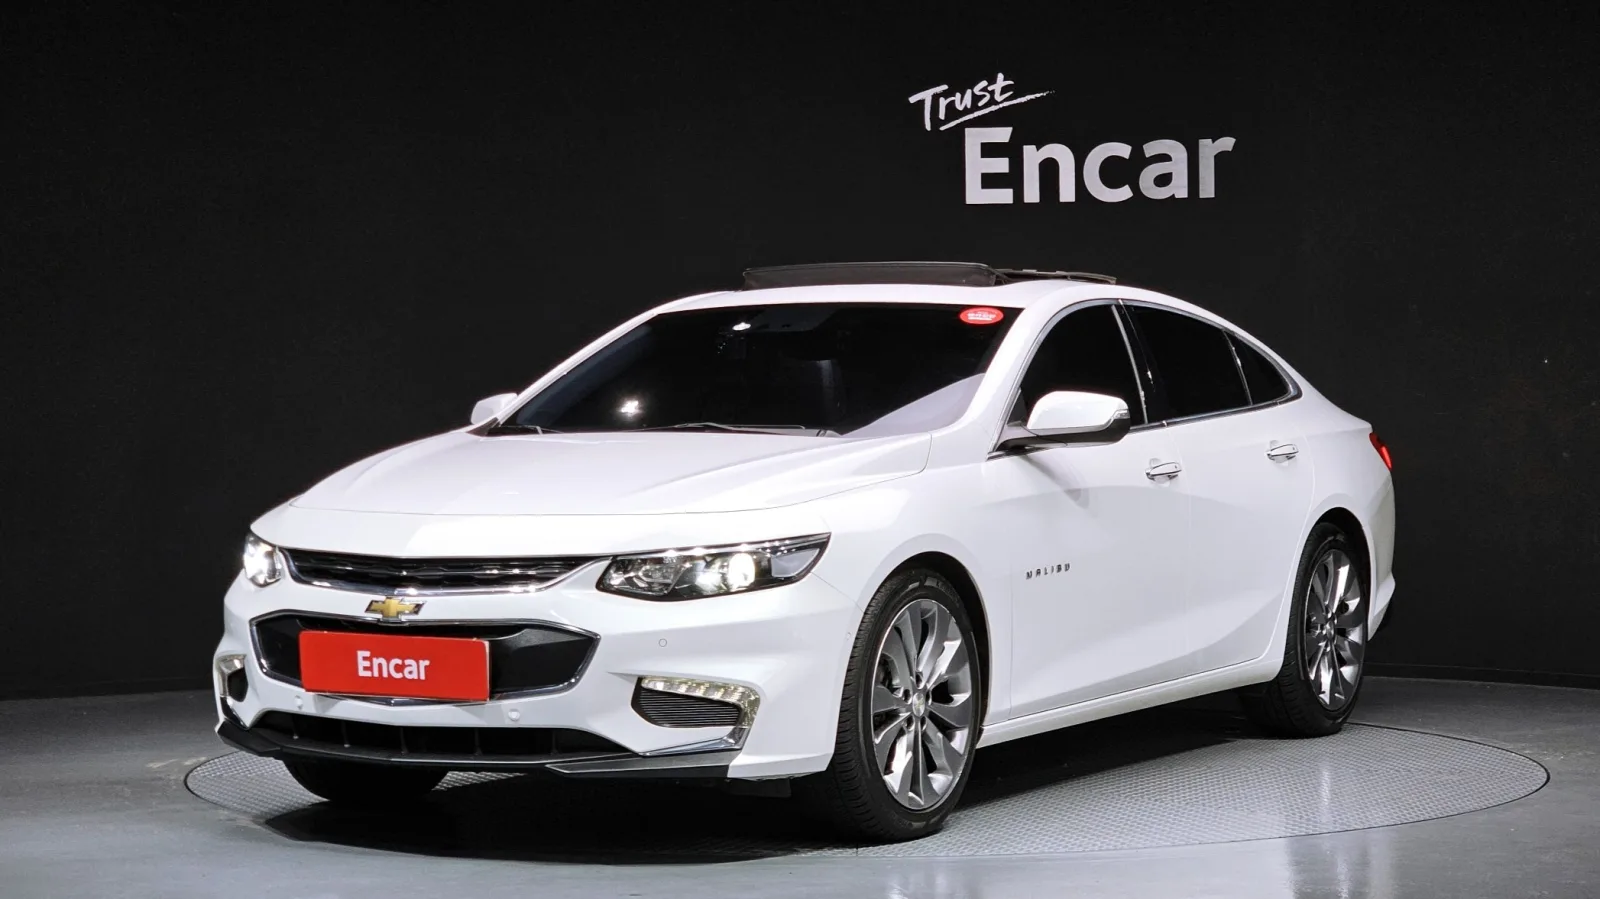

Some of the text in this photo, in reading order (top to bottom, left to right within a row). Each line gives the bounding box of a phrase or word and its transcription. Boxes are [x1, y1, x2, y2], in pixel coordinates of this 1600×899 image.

[908, 72, 1015, 131] Trust
[964, 126, 1236, 205] Encar
[1025, 562, 1071, 580] MALIBU
[356, 650, 431, 680] Encar
